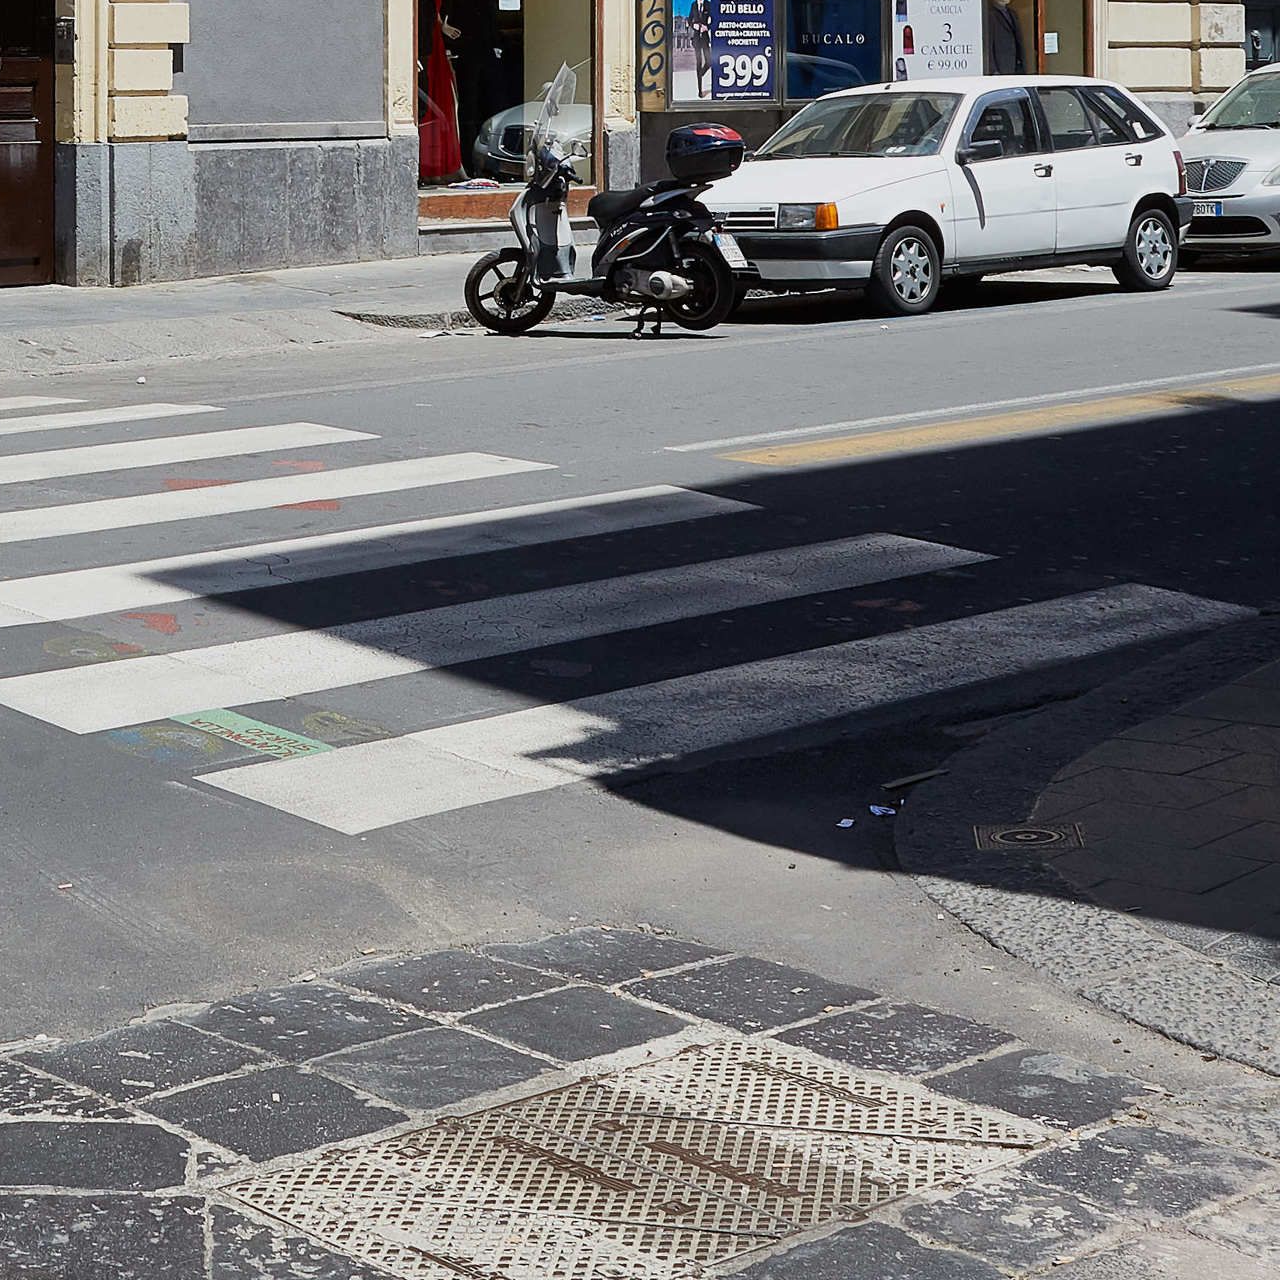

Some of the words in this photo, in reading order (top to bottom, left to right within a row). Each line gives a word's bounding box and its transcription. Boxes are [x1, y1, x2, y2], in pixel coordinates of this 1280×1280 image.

[720, 1, 736, 14] PIÙ
[737, 4, 764, 14] BELLO
[942, 23, 953, 42] 3
[921, 45, 974, 55] CAMICIE
[718, 54, 770, 87] 399
[927, 60, 935, 71] €
[937, 59, 968, 71] 99.00
